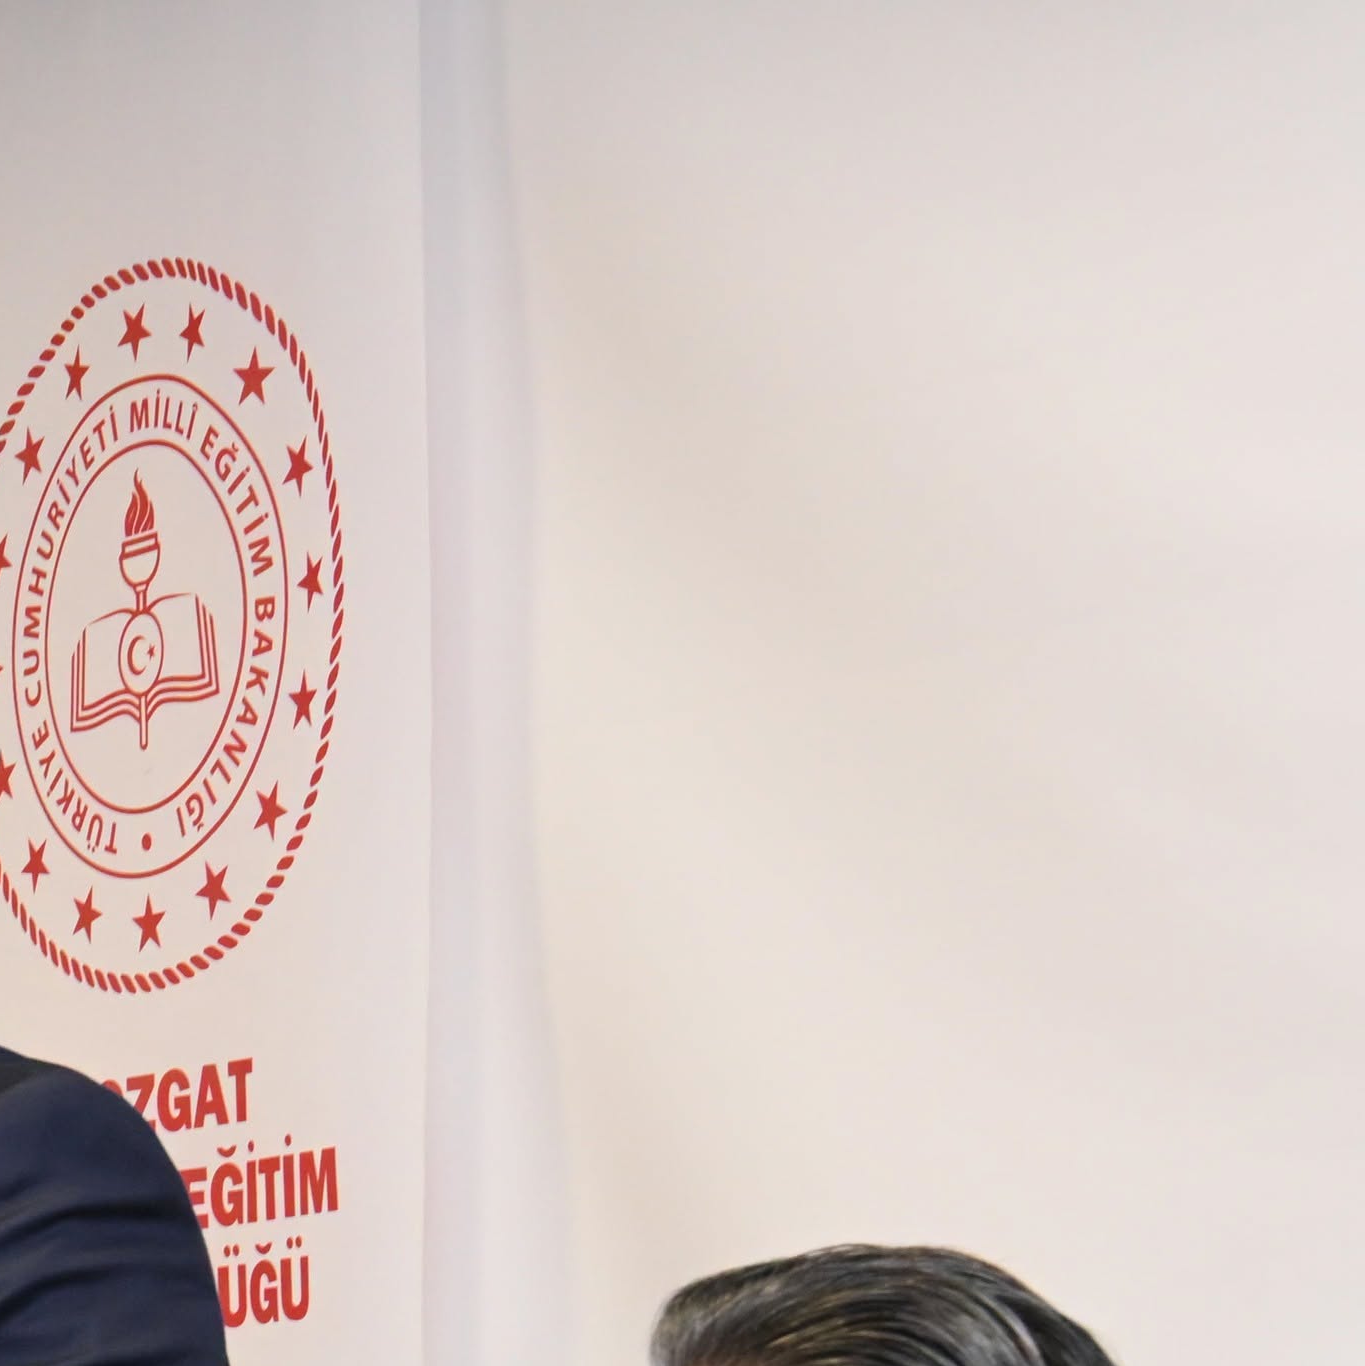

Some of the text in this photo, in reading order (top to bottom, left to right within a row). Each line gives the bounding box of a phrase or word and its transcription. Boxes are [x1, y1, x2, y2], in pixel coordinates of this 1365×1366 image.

[22, 404, 119, 708] CUMHURİYETİ
[199, 424, 274, 577] EĞİTİM
[31, 719, 118, 855] TÜRKİYE
[175, 595, 276, 838] BAKANLIĞI
[101, 1057, 253, 1132] ZGAT
[178, 1133, 339, 1229] EĞİTİM
